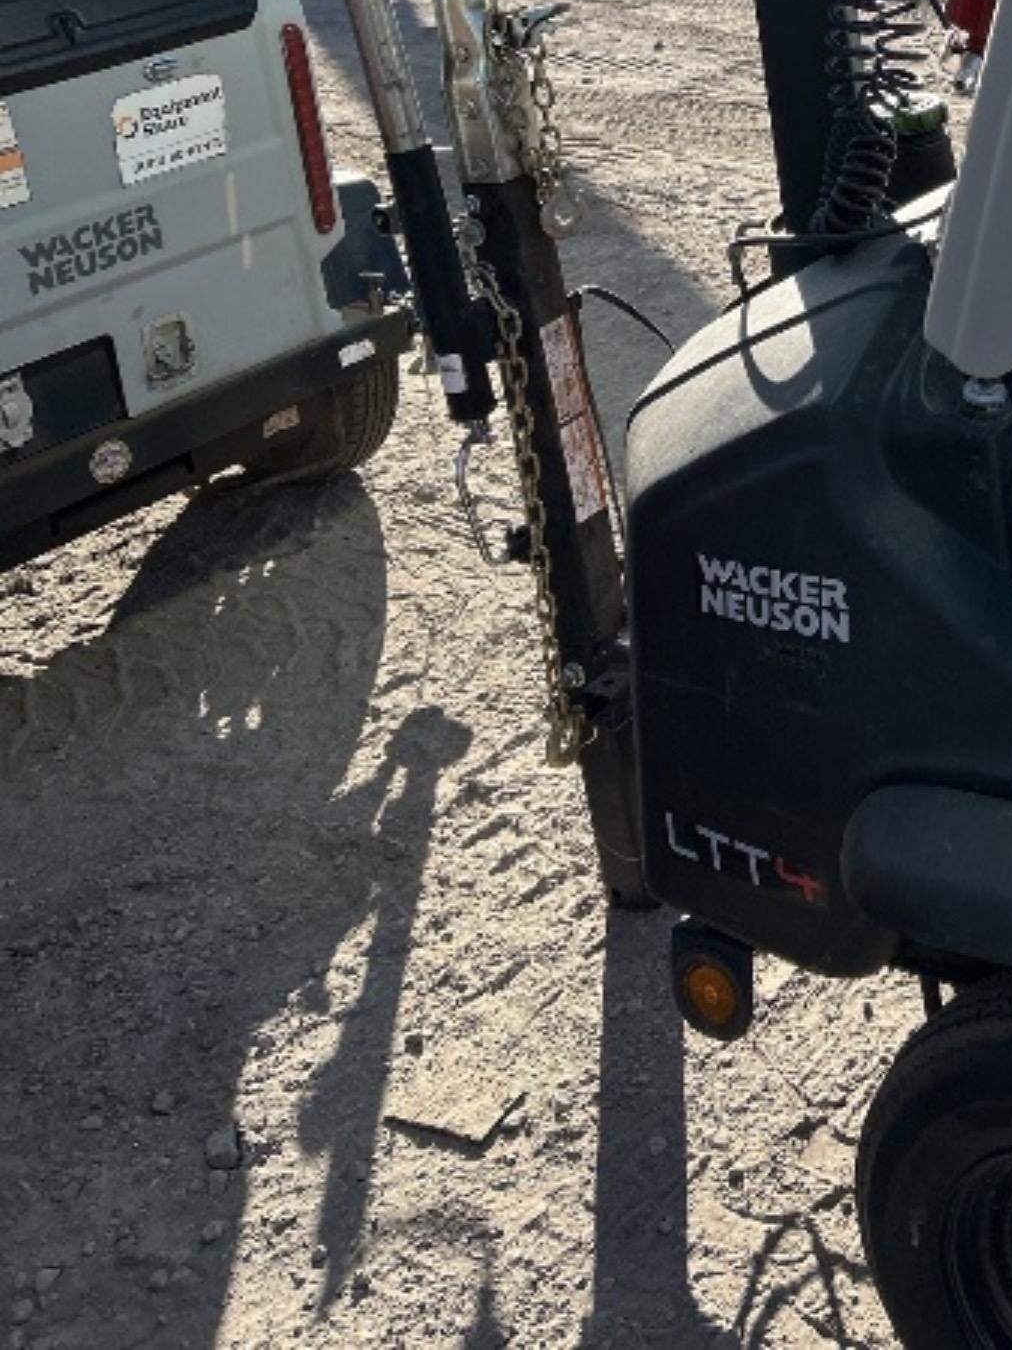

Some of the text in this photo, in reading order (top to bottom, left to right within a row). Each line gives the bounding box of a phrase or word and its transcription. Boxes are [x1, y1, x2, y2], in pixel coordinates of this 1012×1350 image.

[17, 203, 159, 267] WACKER
[27, 227, 163, 297] NEUSON
[697, 551, 849, 610] WACKER
[701, 583, 850, 643] NEUSON
[665, 811, 820, 903] LTT4
